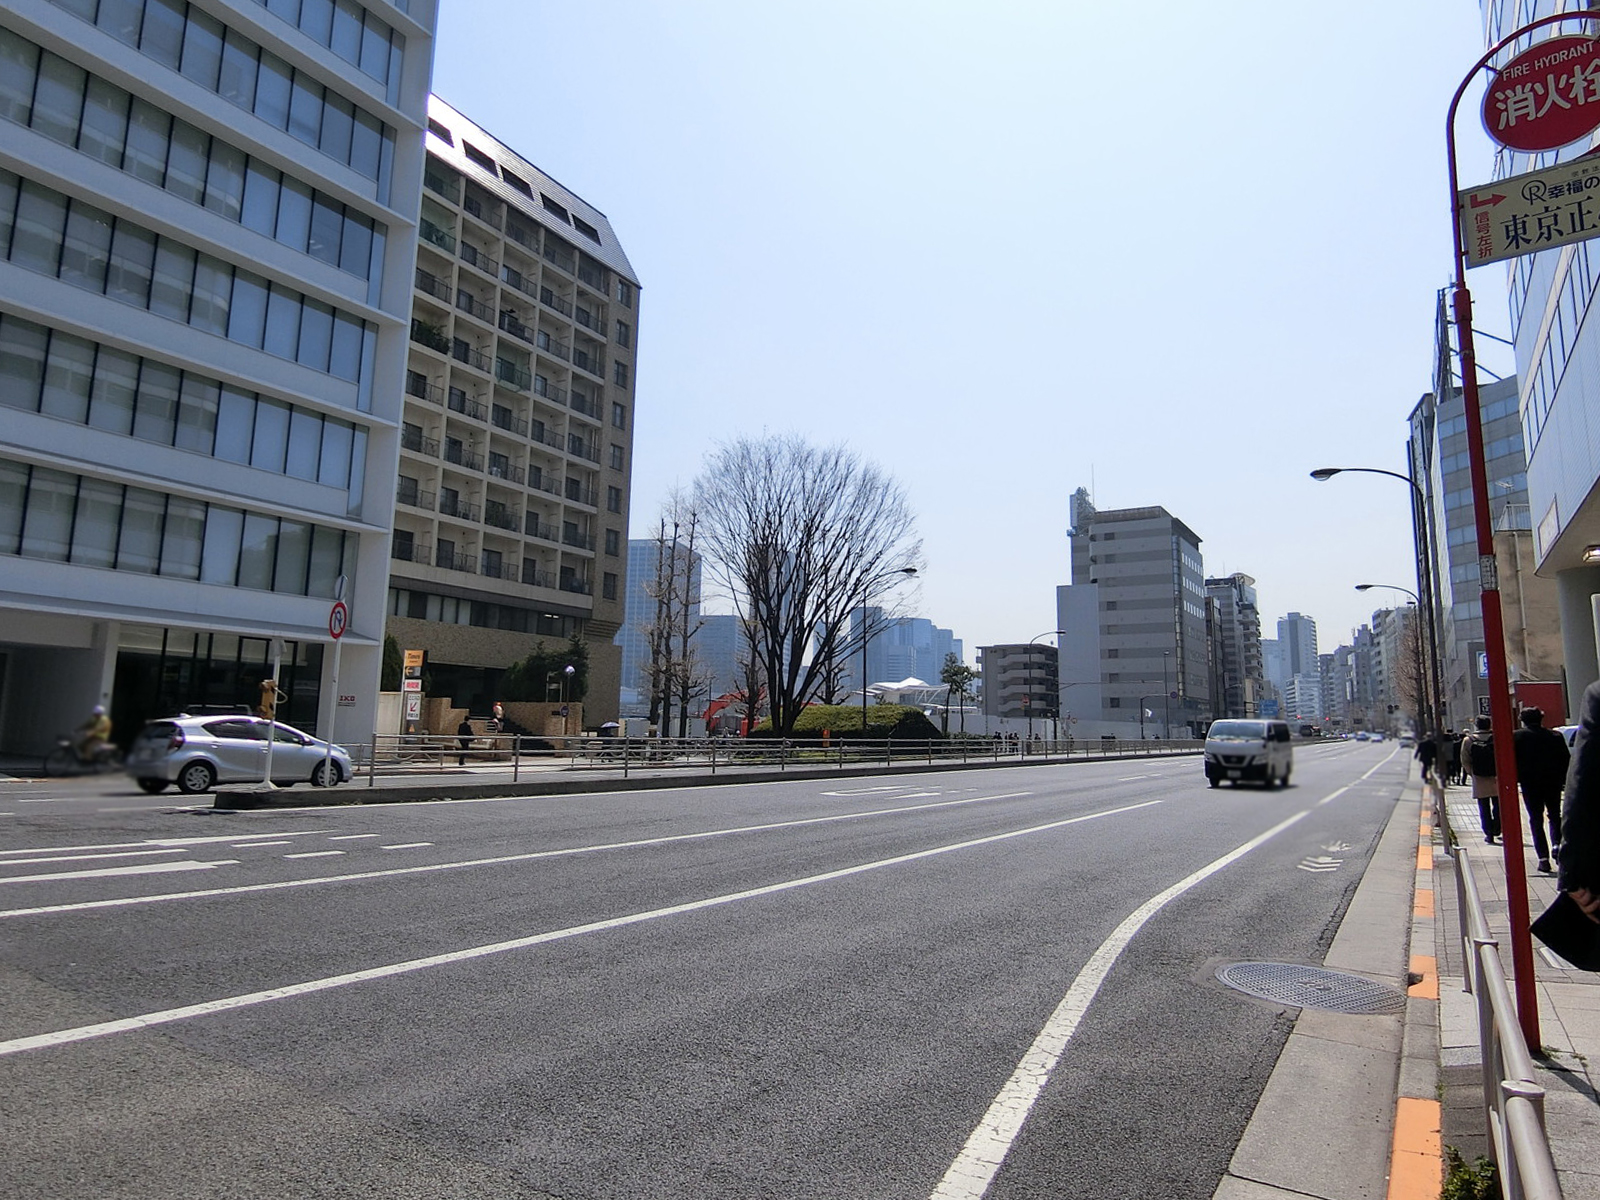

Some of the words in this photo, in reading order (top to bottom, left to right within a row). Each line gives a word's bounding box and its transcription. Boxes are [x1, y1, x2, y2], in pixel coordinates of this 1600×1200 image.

[1502, 62, 1530, 82] FIRE
[1534, 40, 1594, 71] HYDRANT
[1494, 58, 1600, 130] 消火栓
[1547, 176, 1600, 200] 幸福の
[1475, 211, 1492, 259] 信号左折
[1500, 195, 1600, 251] 東京正
